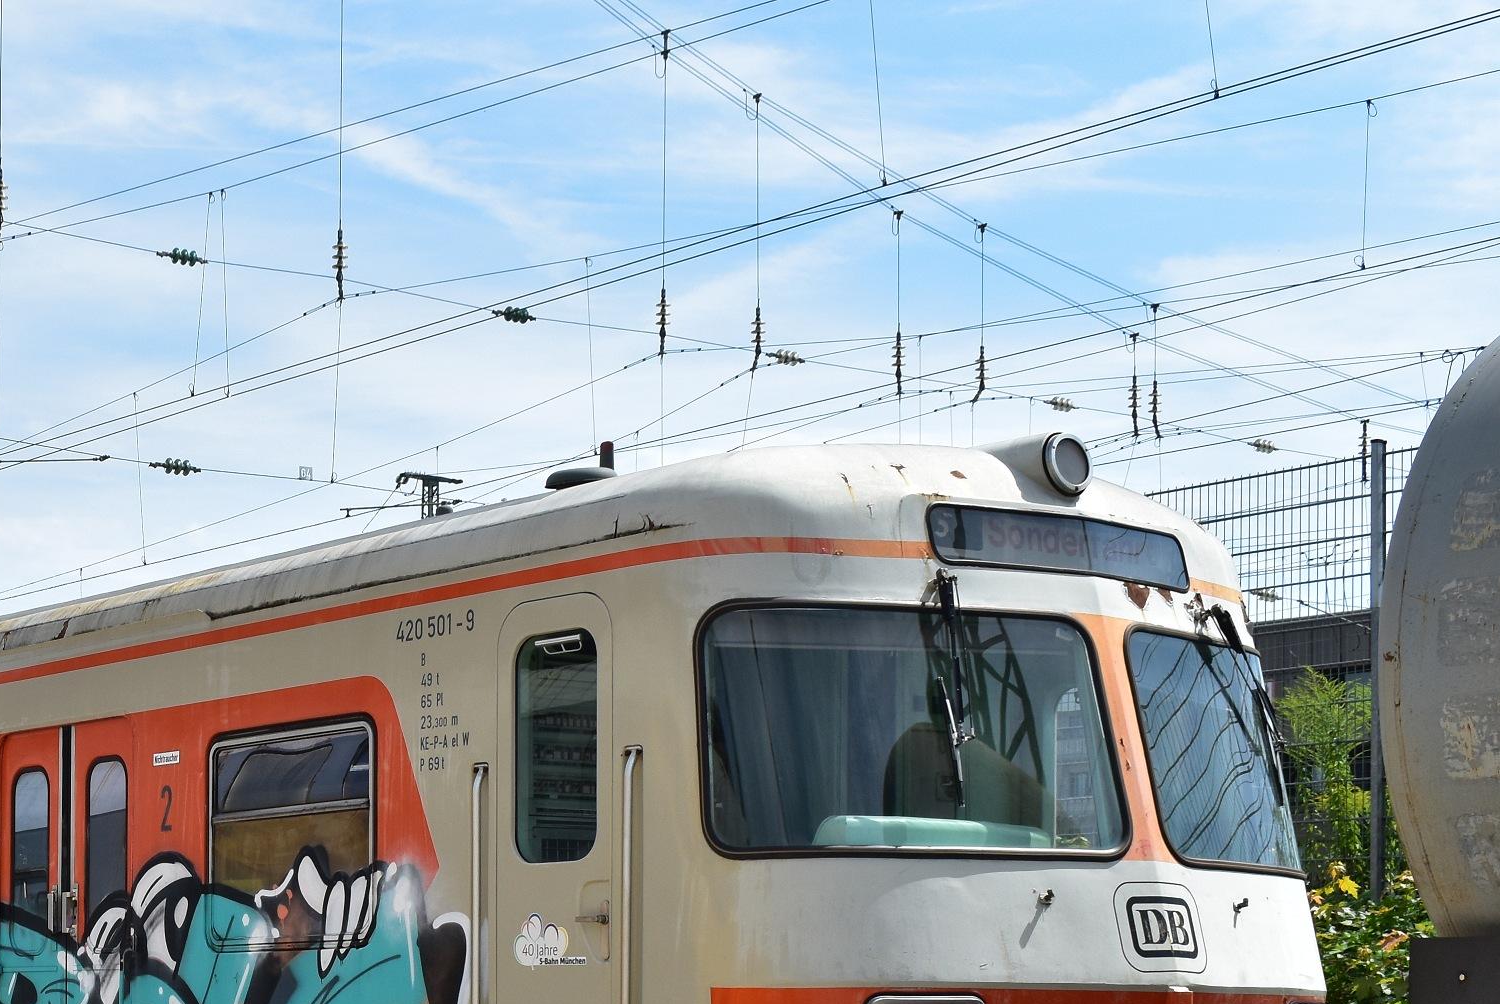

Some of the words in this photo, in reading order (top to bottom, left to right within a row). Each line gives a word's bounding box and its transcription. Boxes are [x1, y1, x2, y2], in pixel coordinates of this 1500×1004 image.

[396, 618, 423, 642] 420
[427, 609, 474, 638] 501-9
[420, 672, 433, 687] 49
[436, 672, 440, 686] t
[420, 693, 432, 709] 65
[420, 714, 448, 730] 23,300
[451, 715, 459, 727] m
[420, 733, 448, 751] KE-P-A
[451, 733, 459, 748] el
[462, 731, 470, 746] W
[420, 758, 425, 772] P
[428, 756, 440, 771] 69
[441, 756, 445, 769] t
[160, 785, 172, 832] 2
[1136, 909, 1190, 946] DB
[522, 943, 535, 957] 40
[536, 943, 558, 959] Jahre
[539, 957, 559, 965] S-Bahn
[560, 957, 586, 965] München
